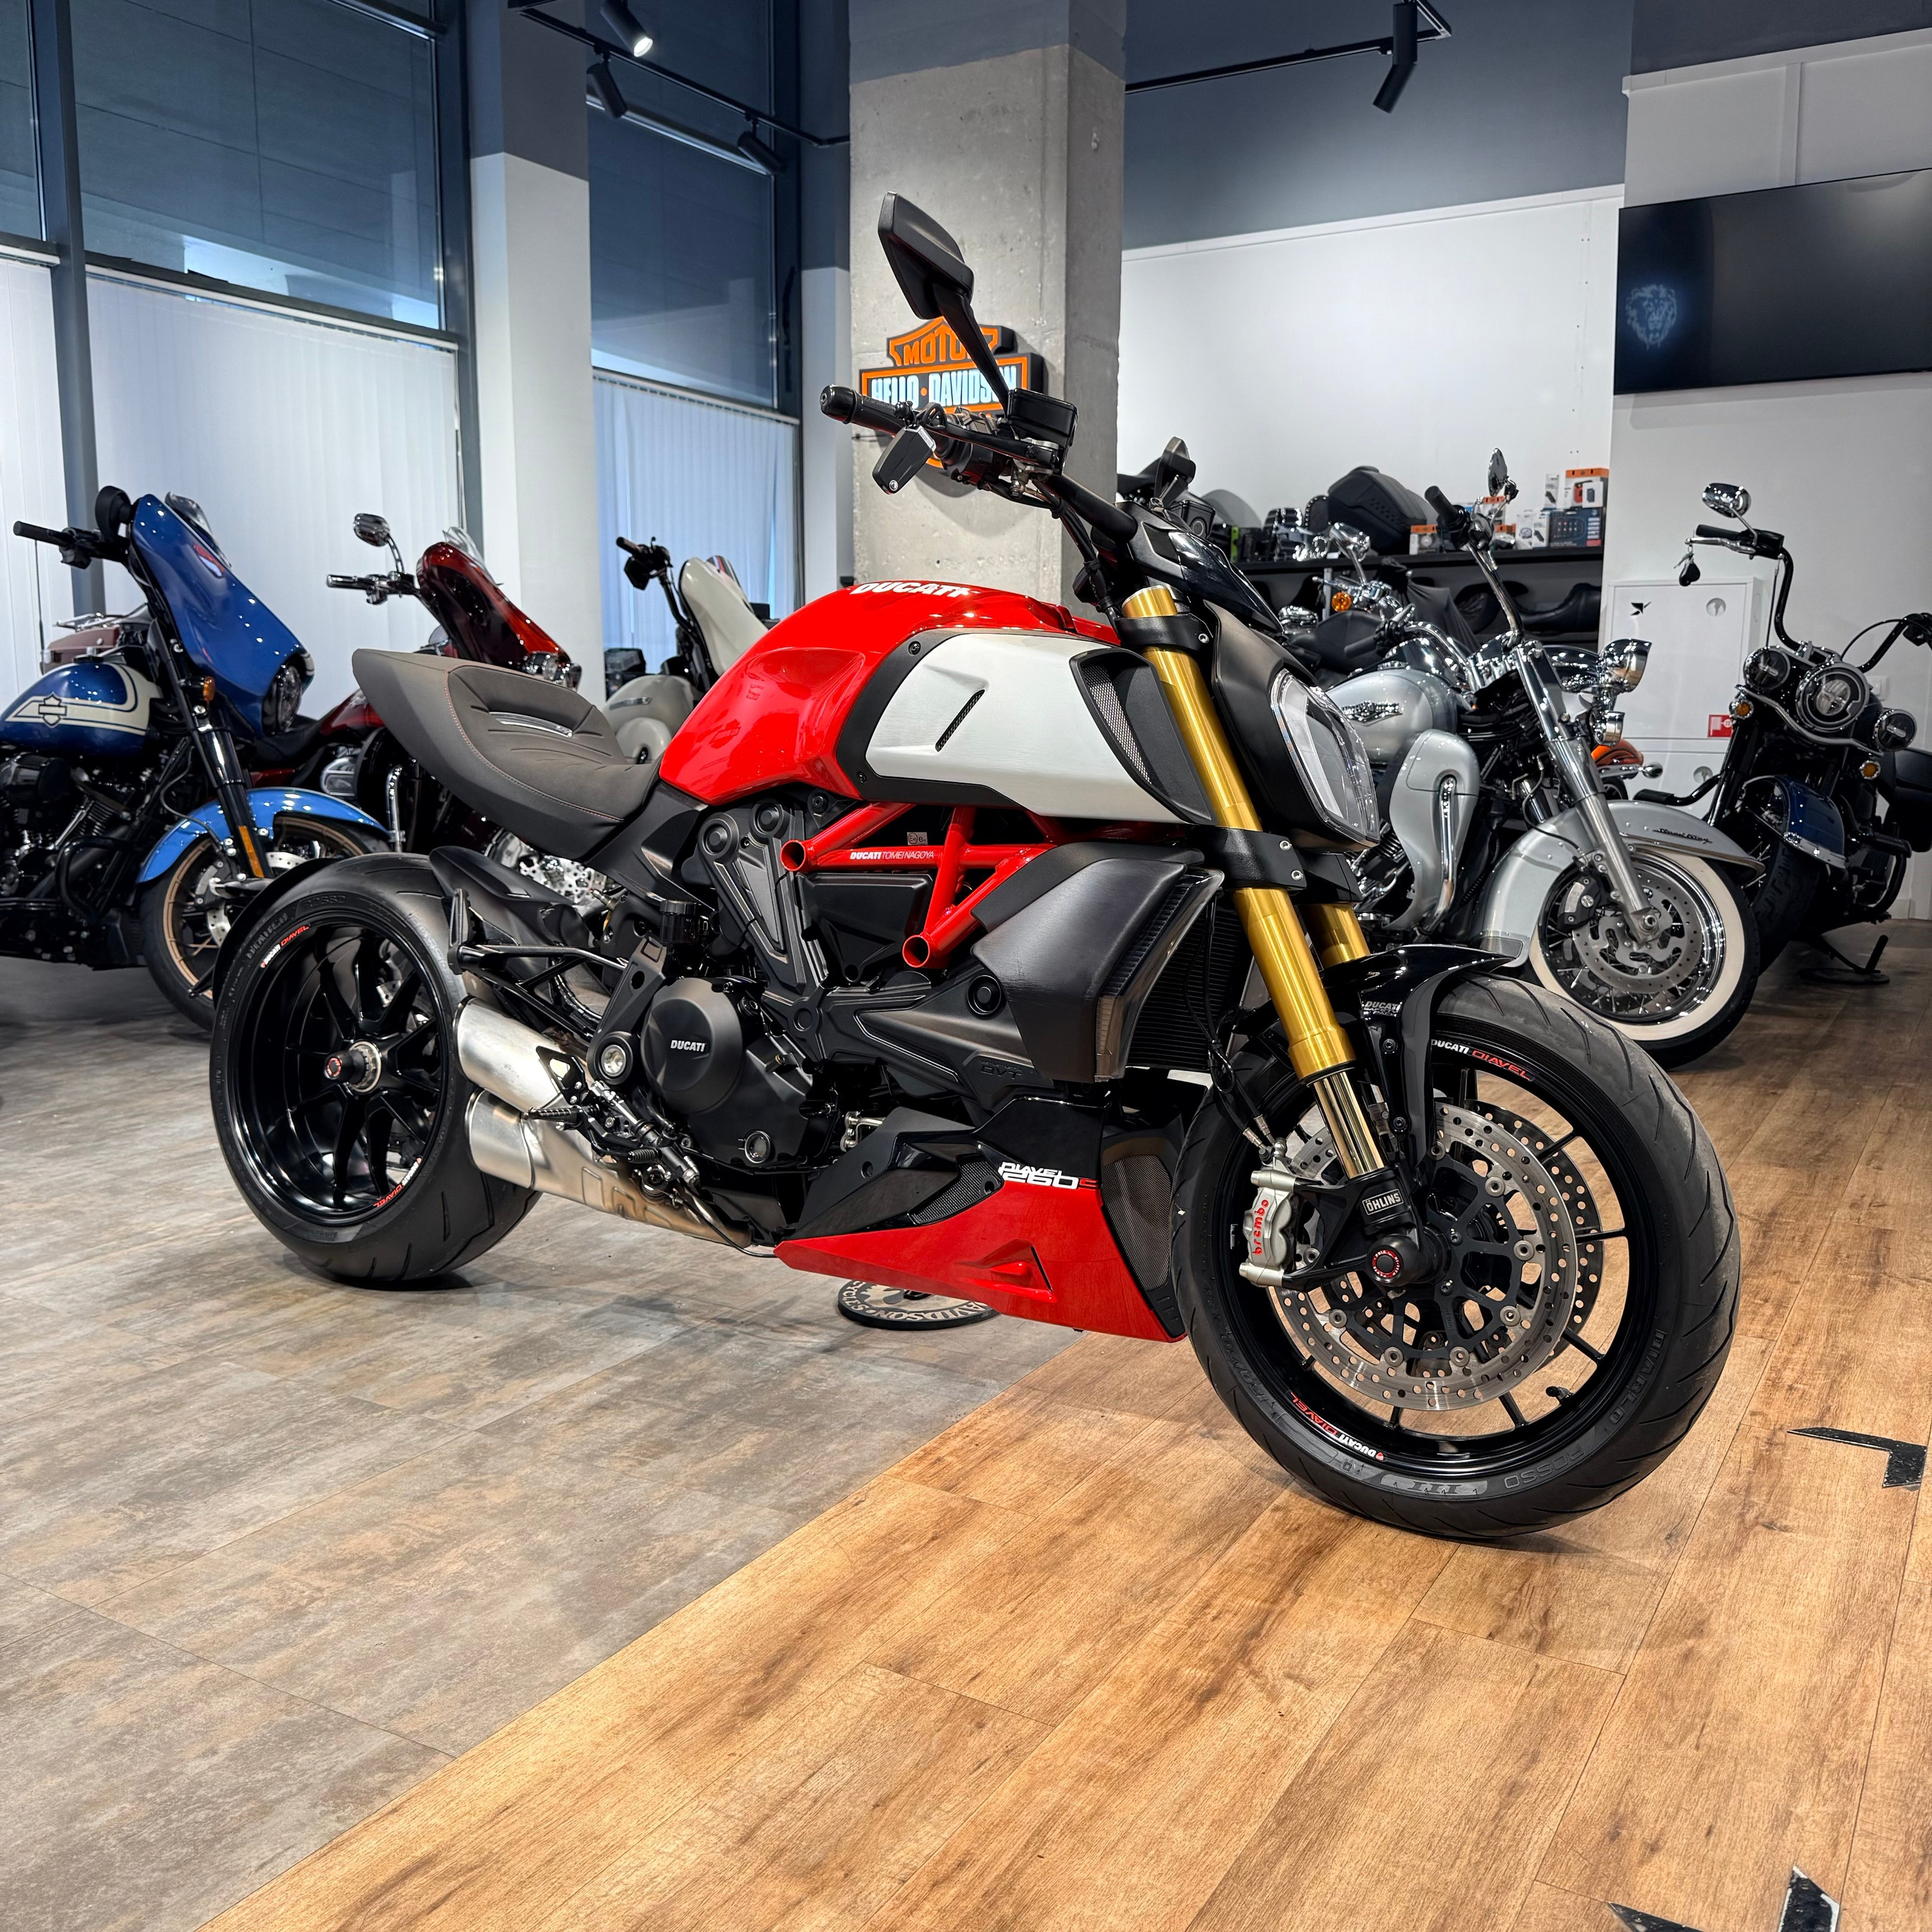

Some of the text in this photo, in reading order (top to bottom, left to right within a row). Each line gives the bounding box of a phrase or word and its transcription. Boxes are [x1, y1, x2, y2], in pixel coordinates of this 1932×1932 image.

[903, 324, 972, 366] MOTO
[850, 851, 881, 860] DUCATI
[280, 924, 309, 947] DIAVEL
[1364, 1001, 1401, 1011] DUCATI
[670, 1039, 706, 1052] DUCATI
[1431, 1038, 1531, 1081] DUCATI DIAVEL
[1365, 1192, 1401, 1212] ÖHLINS
[1252, 1198, 1269, 1256] brembo
[1609, 1328, 1667, 1425] DIABLO
[1290, 1391, 1376, 1459] DUCATI DIAVEL
[1503, 1442, 1585, 1490] ROSSO
